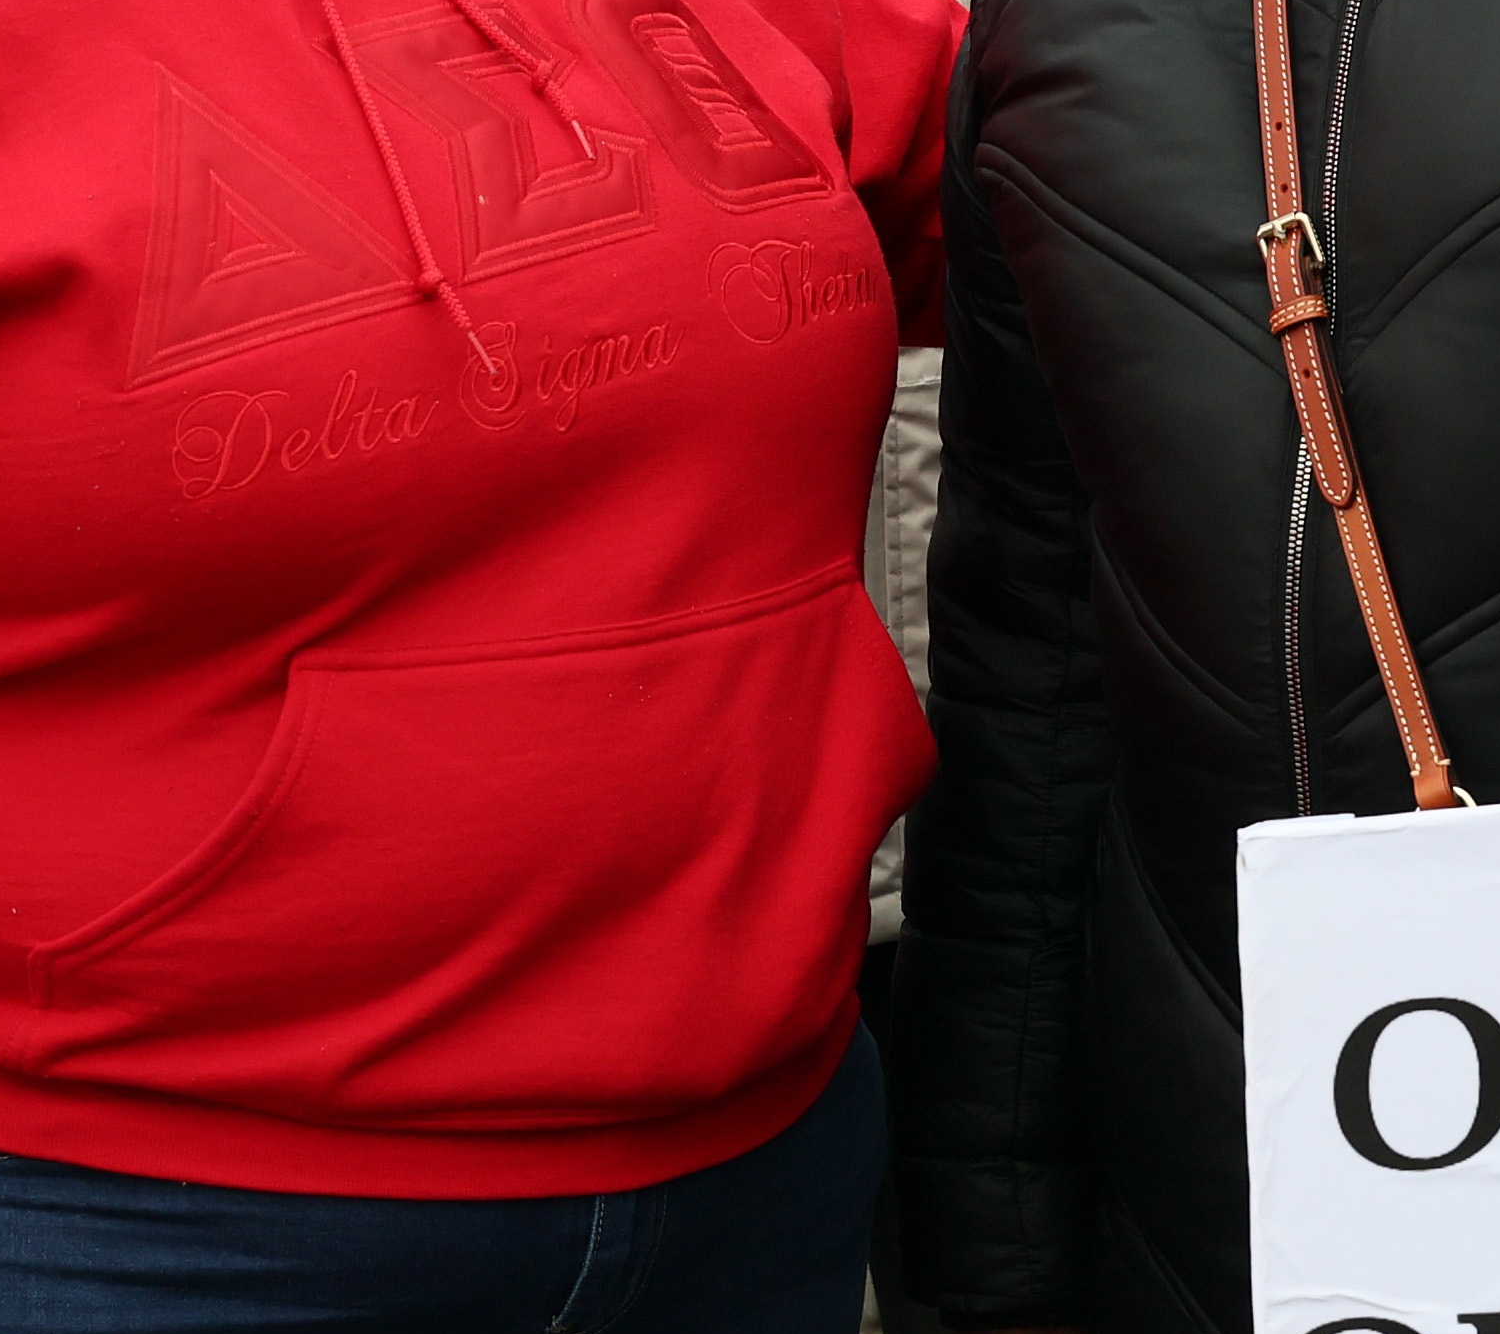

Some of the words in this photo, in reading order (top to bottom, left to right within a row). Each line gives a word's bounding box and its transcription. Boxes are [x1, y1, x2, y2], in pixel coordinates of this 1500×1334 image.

[171, 368, 442, 499] Delta
[458, 320, 685, 432] Sigma
[706, 238, 878, 345] Theta
